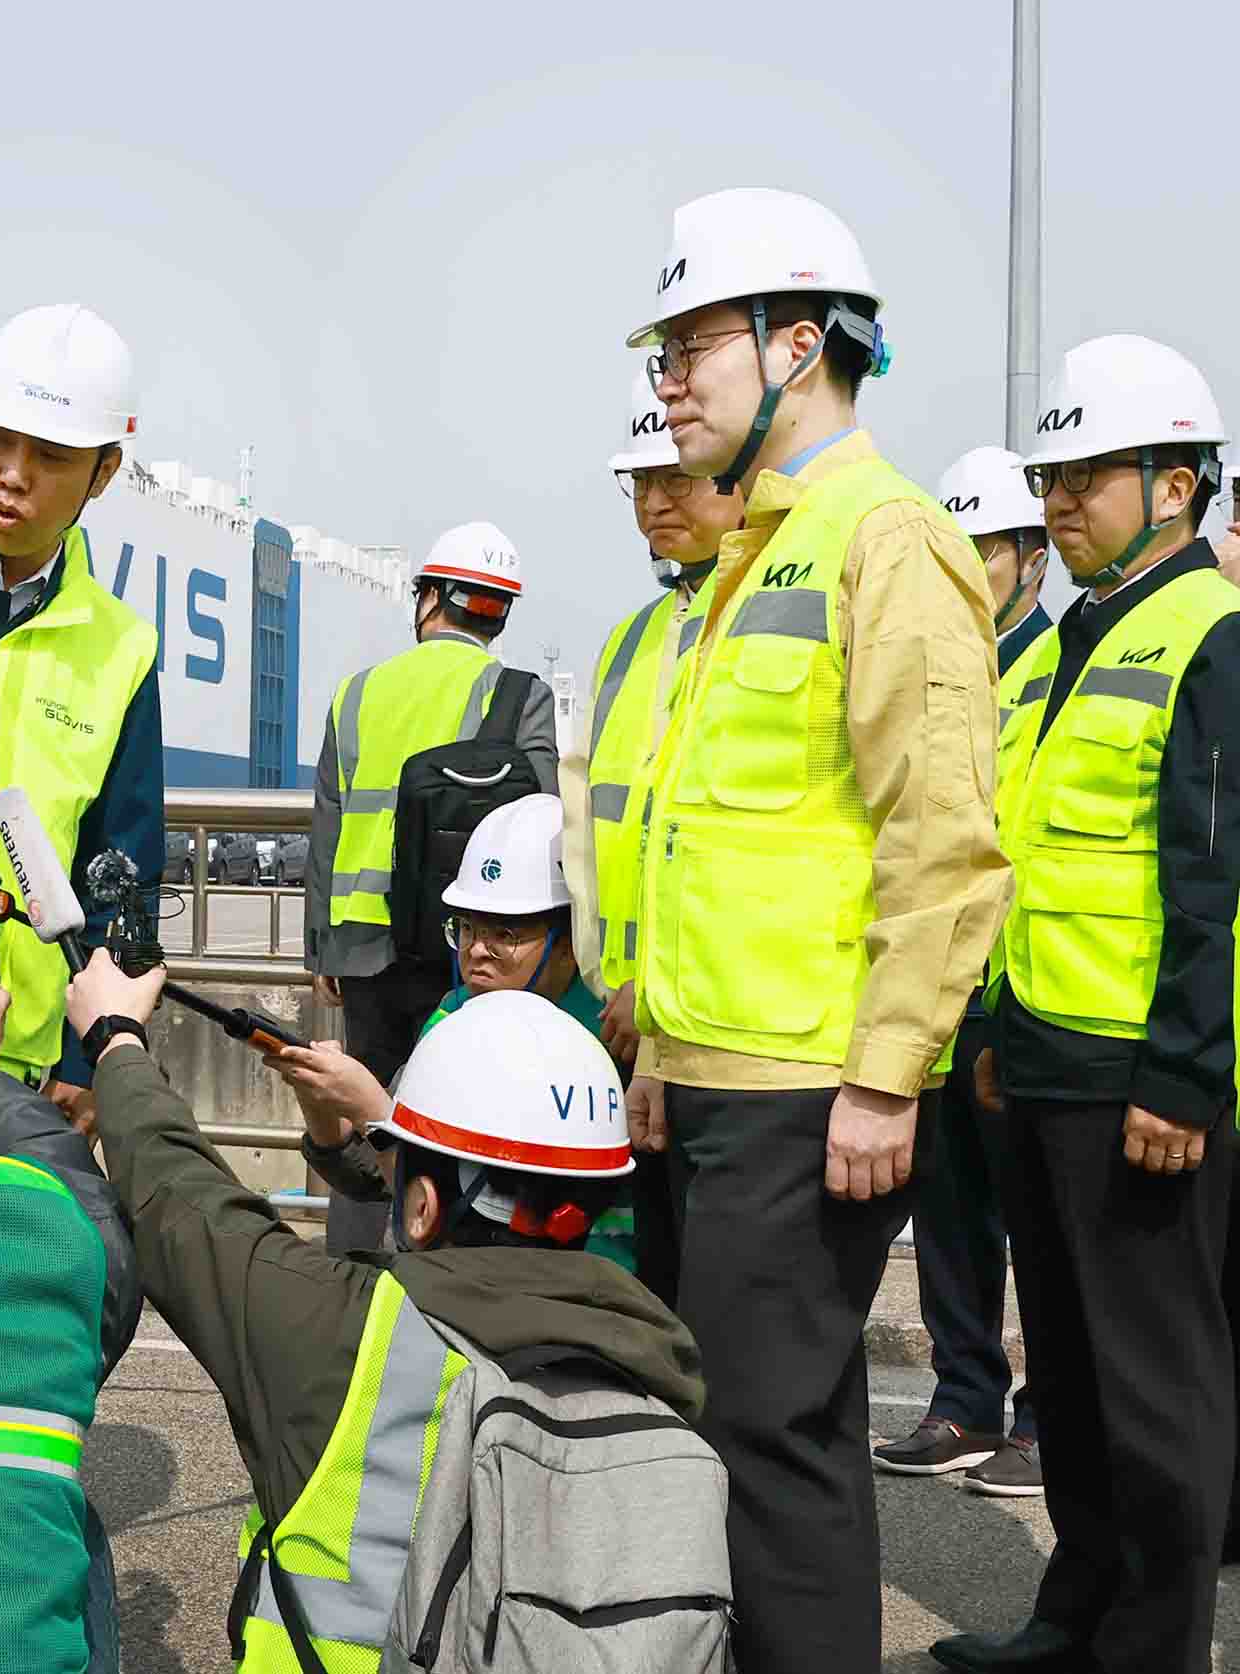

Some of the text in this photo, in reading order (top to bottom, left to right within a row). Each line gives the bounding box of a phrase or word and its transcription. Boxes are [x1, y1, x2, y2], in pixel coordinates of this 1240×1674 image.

[24, 387, 70, 406] GLOVIS
[483, 551, 517, 567] VIP
[45, 708, 95, 734] GLOVIS
[0, 820, 32, 896] REUTERS
[549, 1084, 619, 1123] VIP
